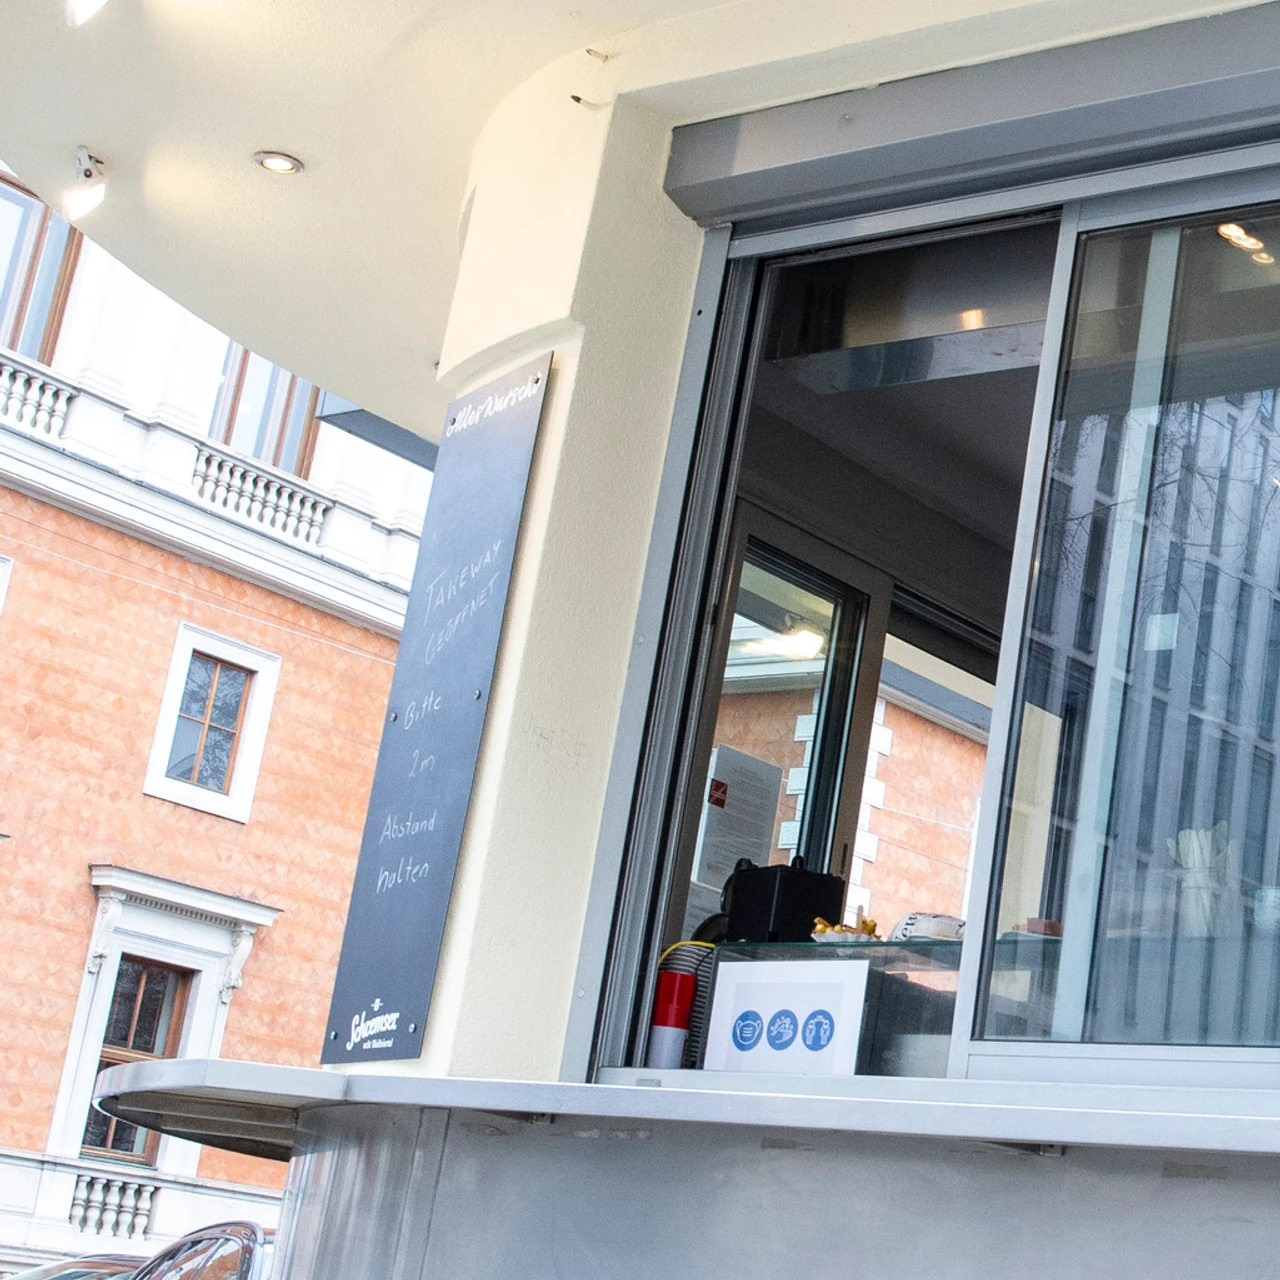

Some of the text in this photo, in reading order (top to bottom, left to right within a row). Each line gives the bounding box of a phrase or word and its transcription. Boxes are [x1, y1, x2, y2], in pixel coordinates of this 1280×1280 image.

[404, 690, 441, 730] Bitte
[379, 809, 437, 845] Abstand
[377, 856, 429, 894] halten
[346, 1010, 400, 1051] Schremser
